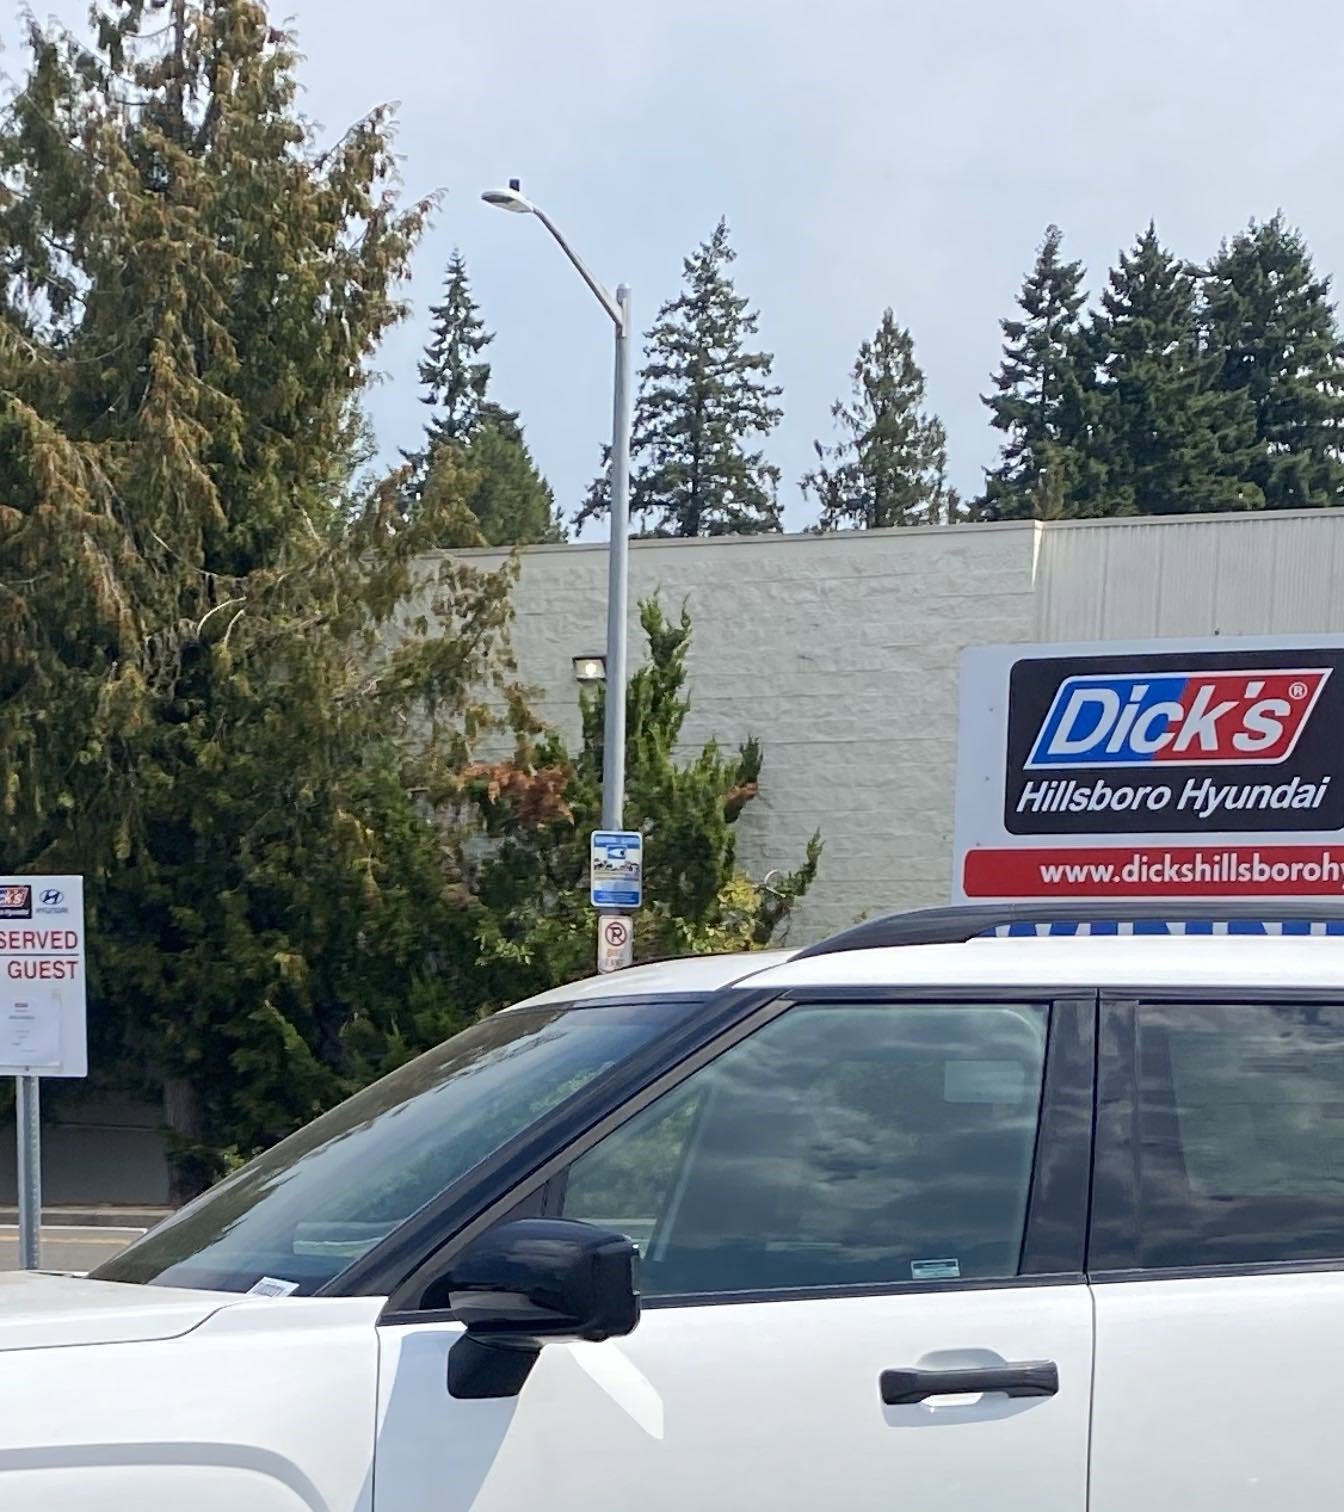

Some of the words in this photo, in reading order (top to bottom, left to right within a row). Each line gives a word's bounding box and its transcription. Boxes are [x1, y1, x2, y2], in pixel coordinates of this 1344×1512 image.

[1016, 779, 1172, 812] Hillsboro
[1177, 777, 1331, 818] Hyundai
[7, 960, 79, 980] GUEST
